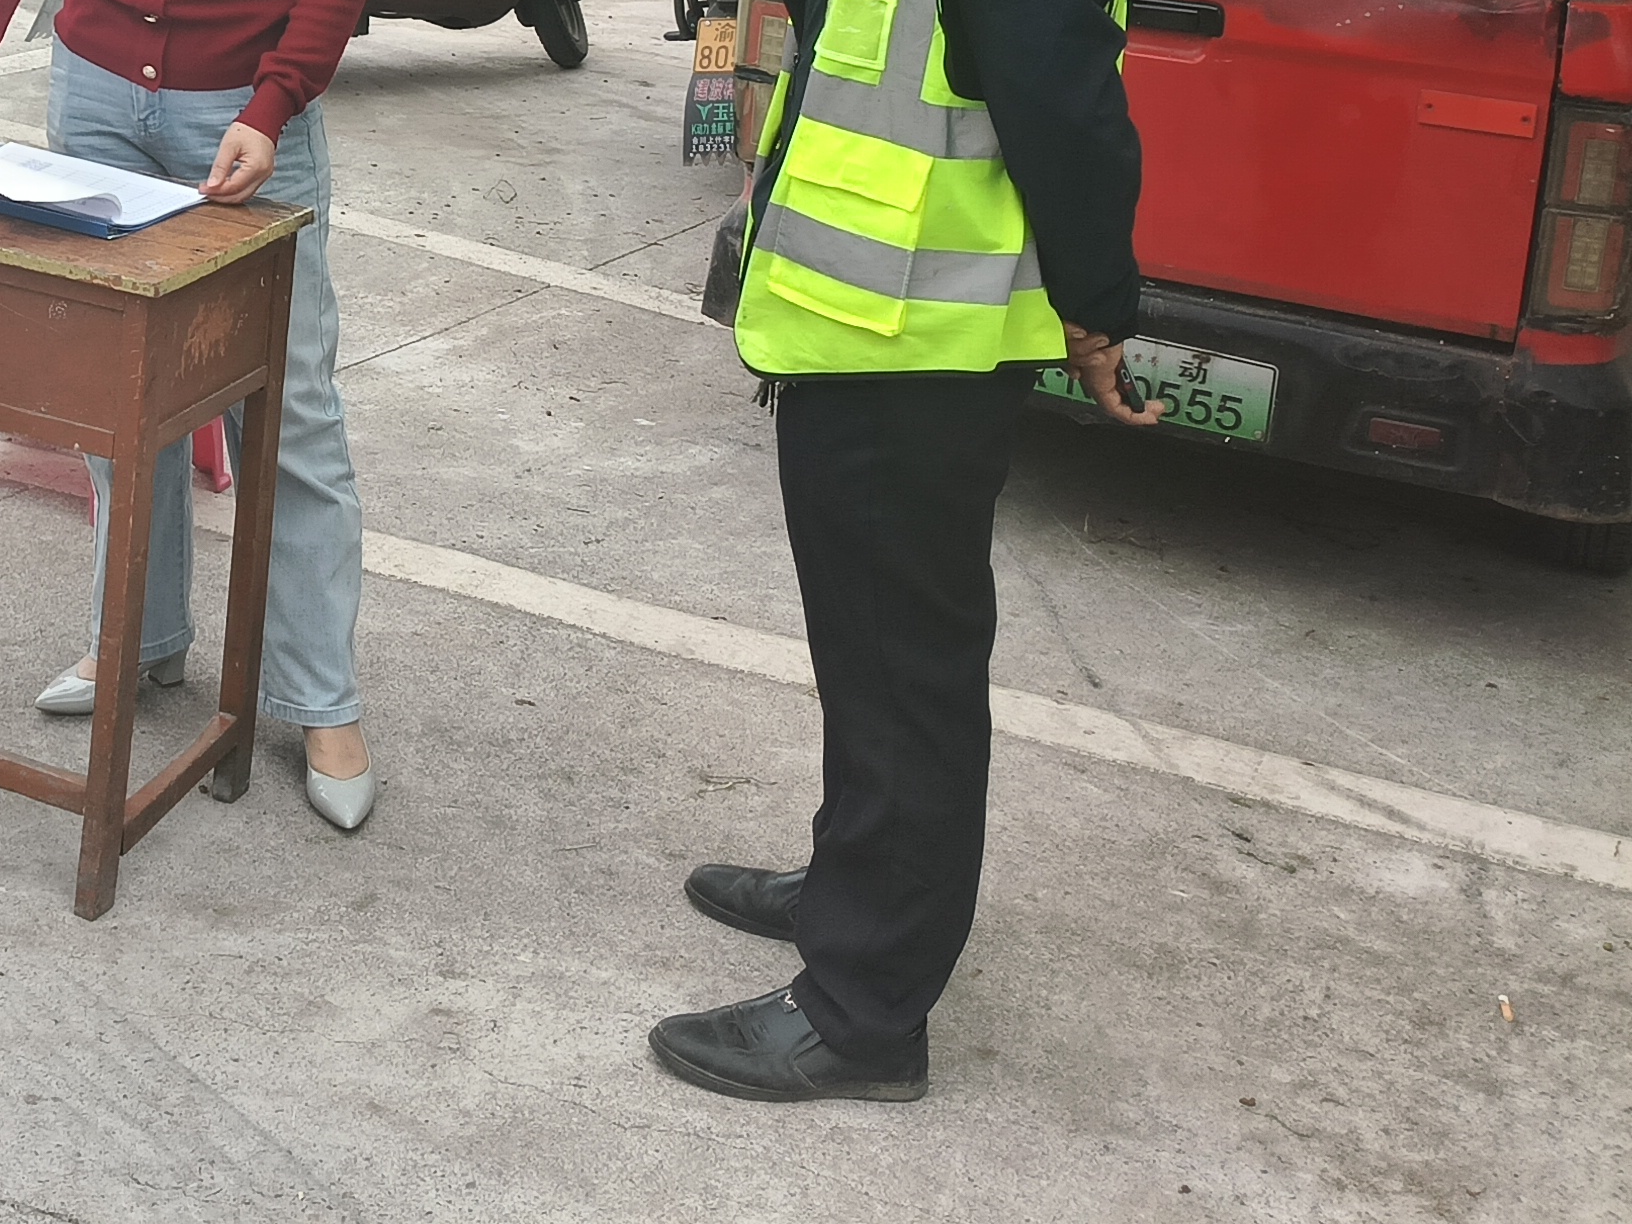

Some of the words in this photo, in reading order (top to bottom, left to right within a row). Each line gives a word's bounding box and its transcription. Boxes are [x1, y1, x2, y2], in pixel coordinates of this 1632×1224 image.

[714, 22, 736, 43] 渝
[699, 45, 736, 69] 80
[1179, 360, 1208, 385] 动
